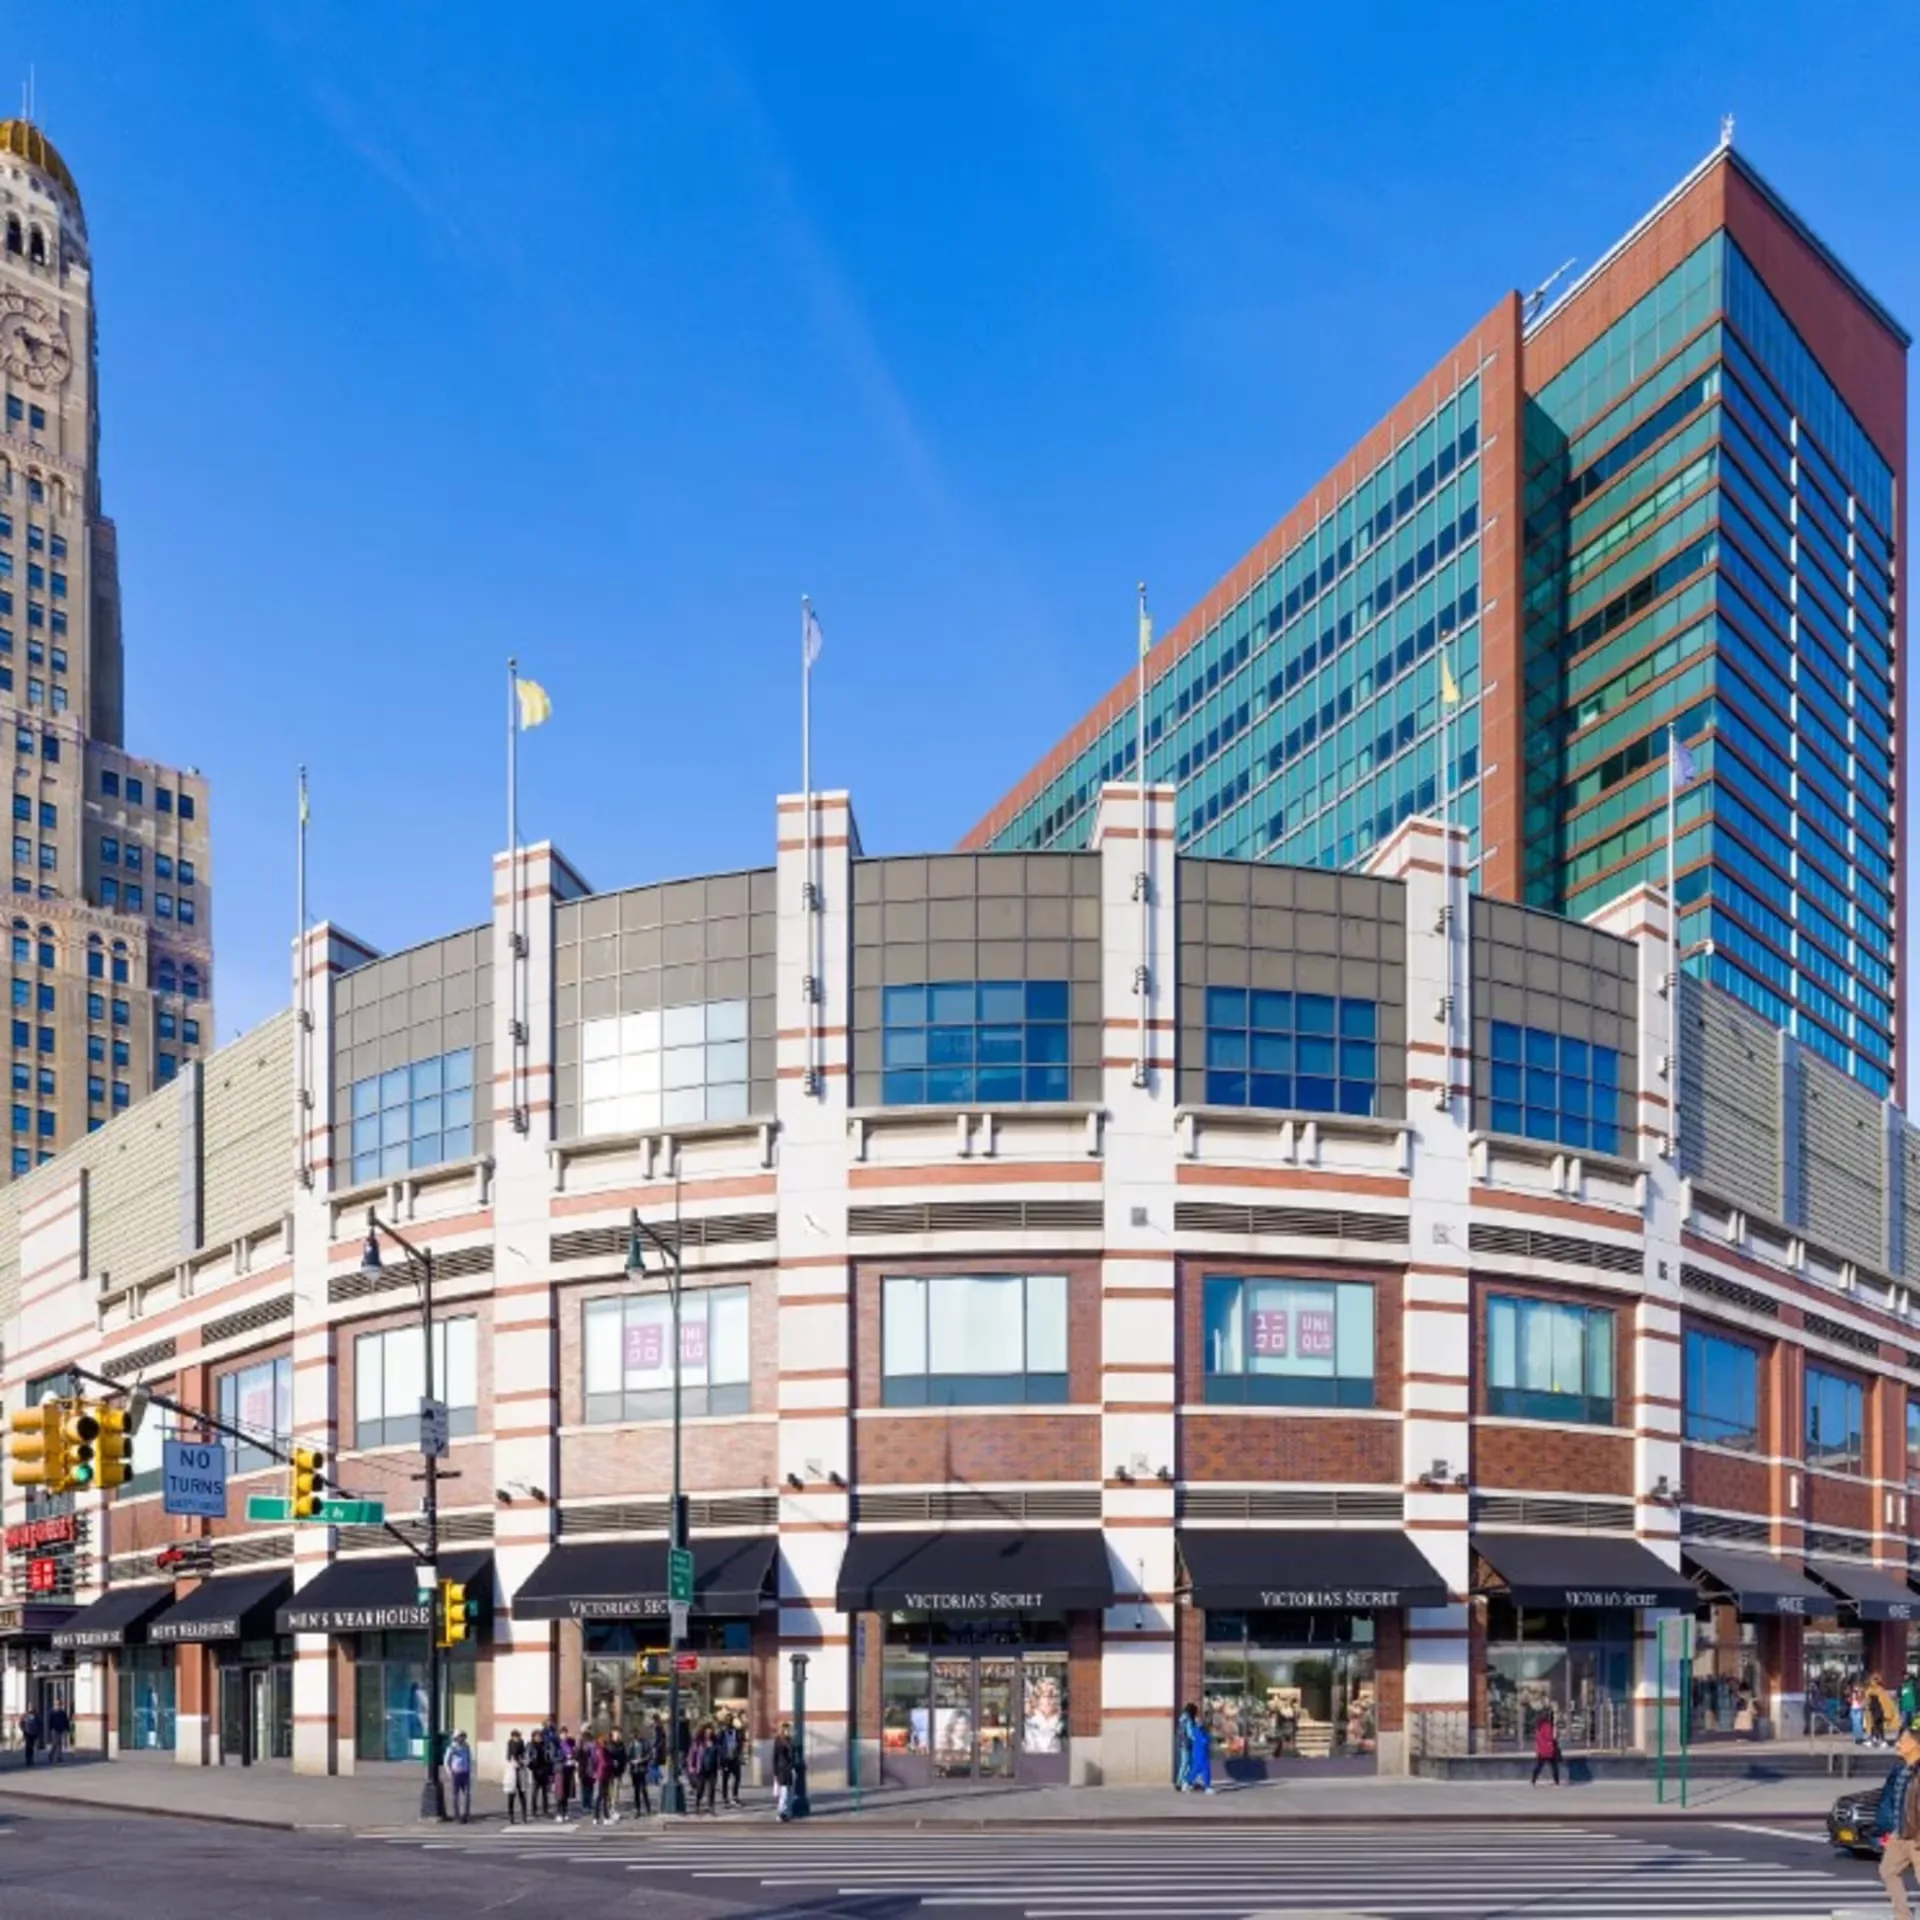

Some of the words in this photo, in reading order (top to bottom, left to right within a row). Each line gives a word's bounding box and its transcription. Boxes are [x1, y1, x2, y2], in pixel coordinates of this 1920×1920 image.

[1302, 1315, 1329, 1332] UNI
[180, 1449, 210, 1469] NO
[169, 1475, 223, 1495] TURNS
[904, 1593, 987, 1609] VICTORIA'S
[990, 1591, 1043, 1609] SECRET
[1261, 1591, 1342, 1607] VICTORIA'S
[1345, 1589, 1399, 1606] SECRET
[569, 1599, 641, 1616] VICTORIA'S
[288, 1611, 329, 1629] MEN'S
[334, 1606, 430, 1628] WEARHOUSE
